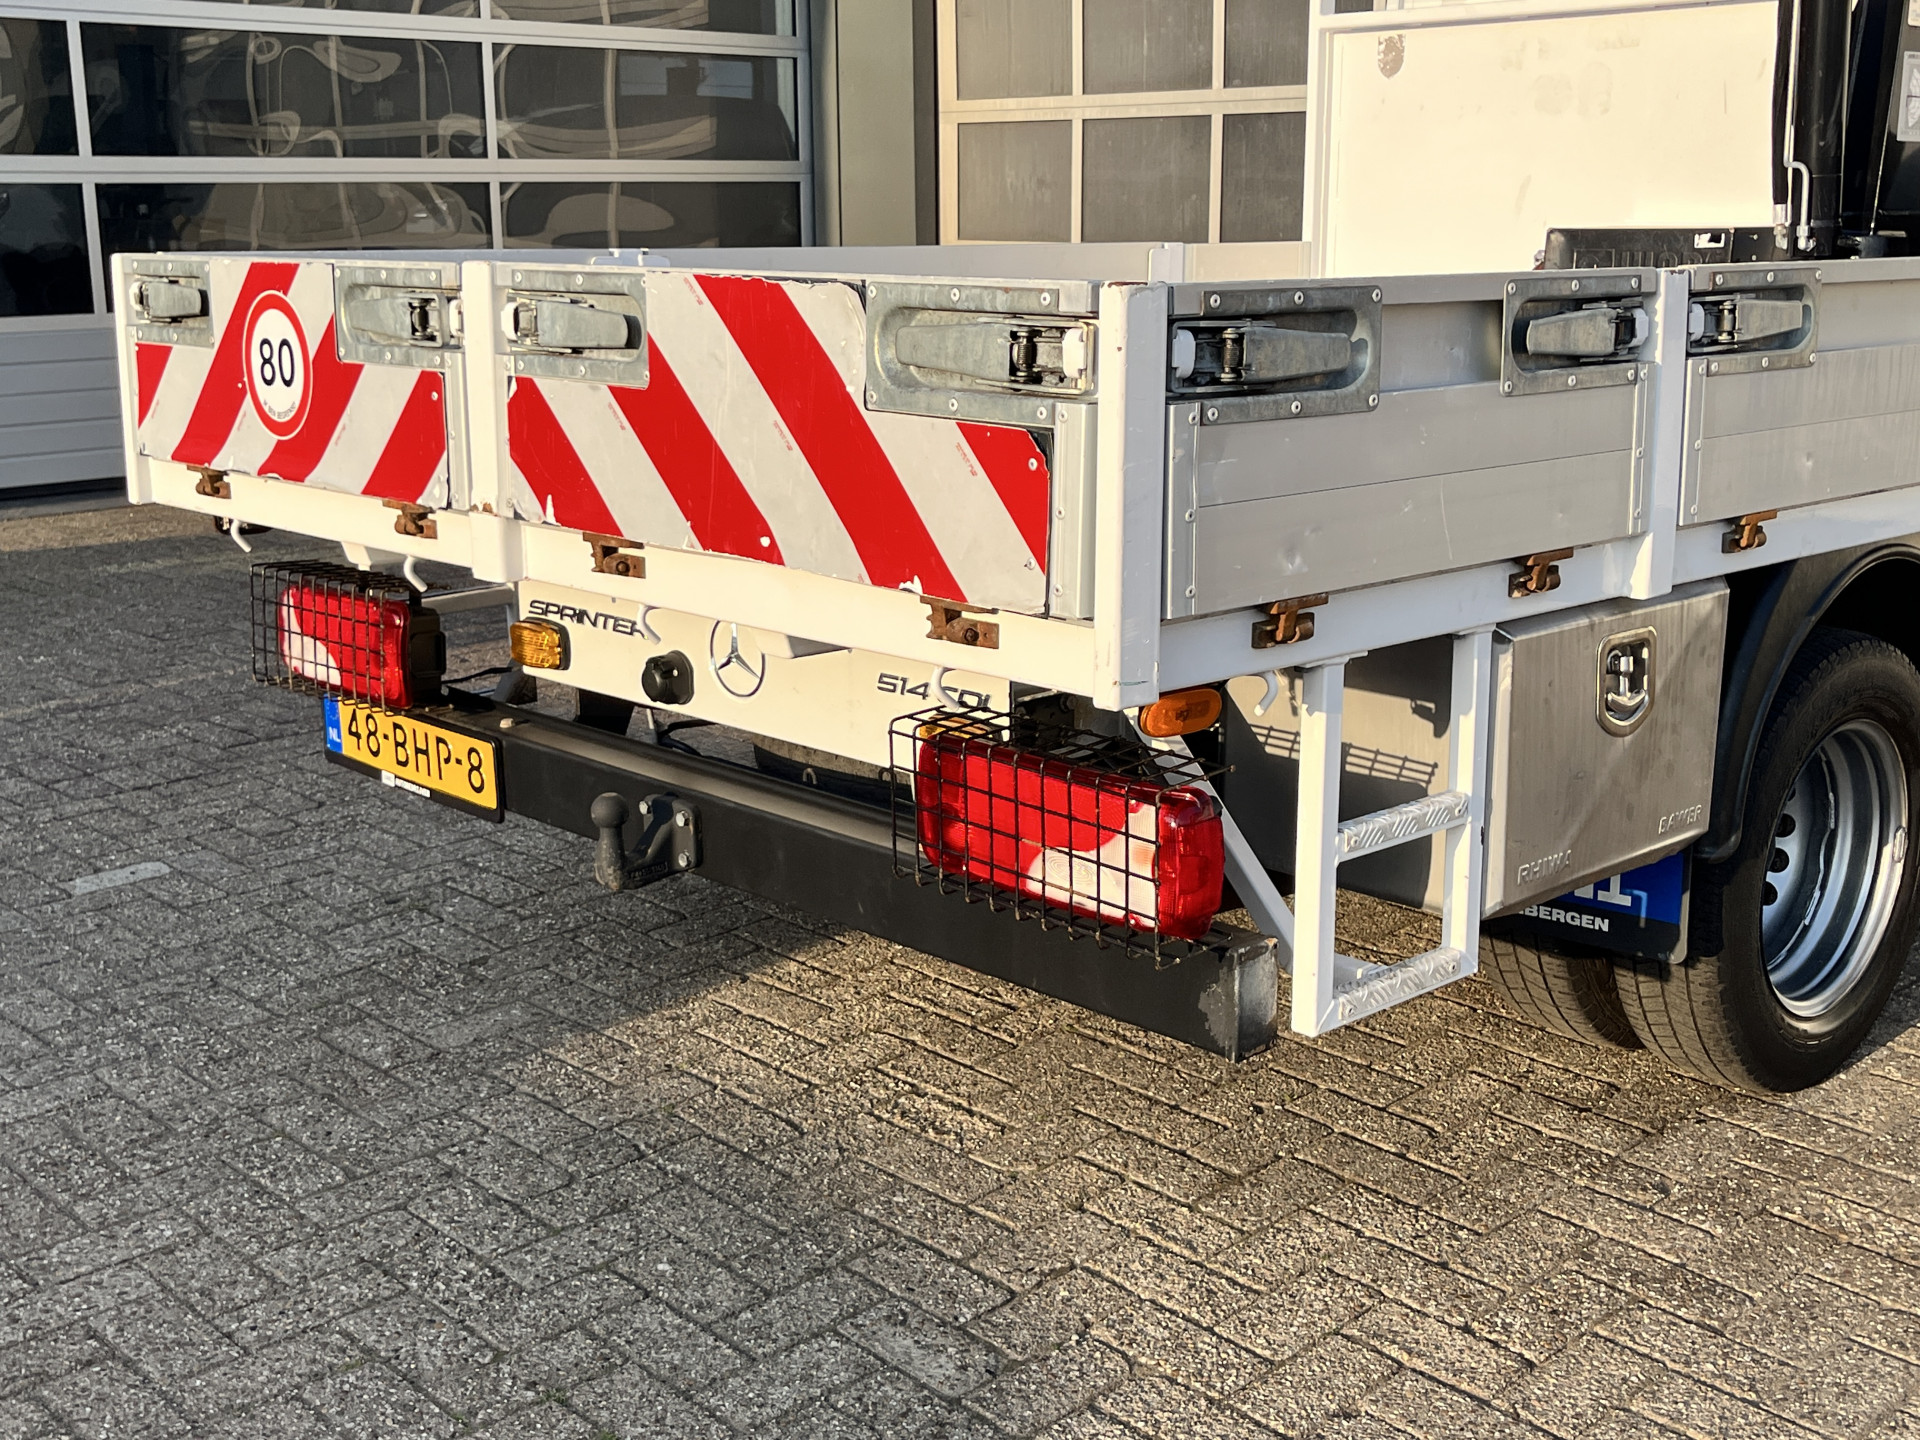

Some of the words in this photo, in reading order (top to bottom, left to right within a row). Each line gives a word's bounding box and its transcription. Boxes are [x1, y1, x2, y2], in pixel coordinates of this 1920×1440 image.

[259, 337, 295, 388] 80
[528, 599, 648, 640] SPRINTER
[877, 672, 930, 700] 514
[328, 726, 342, 744] NL
[347, 707, 486, 795] 48-BHP-8
[1518, 903, 1610, 933] BERGEN
